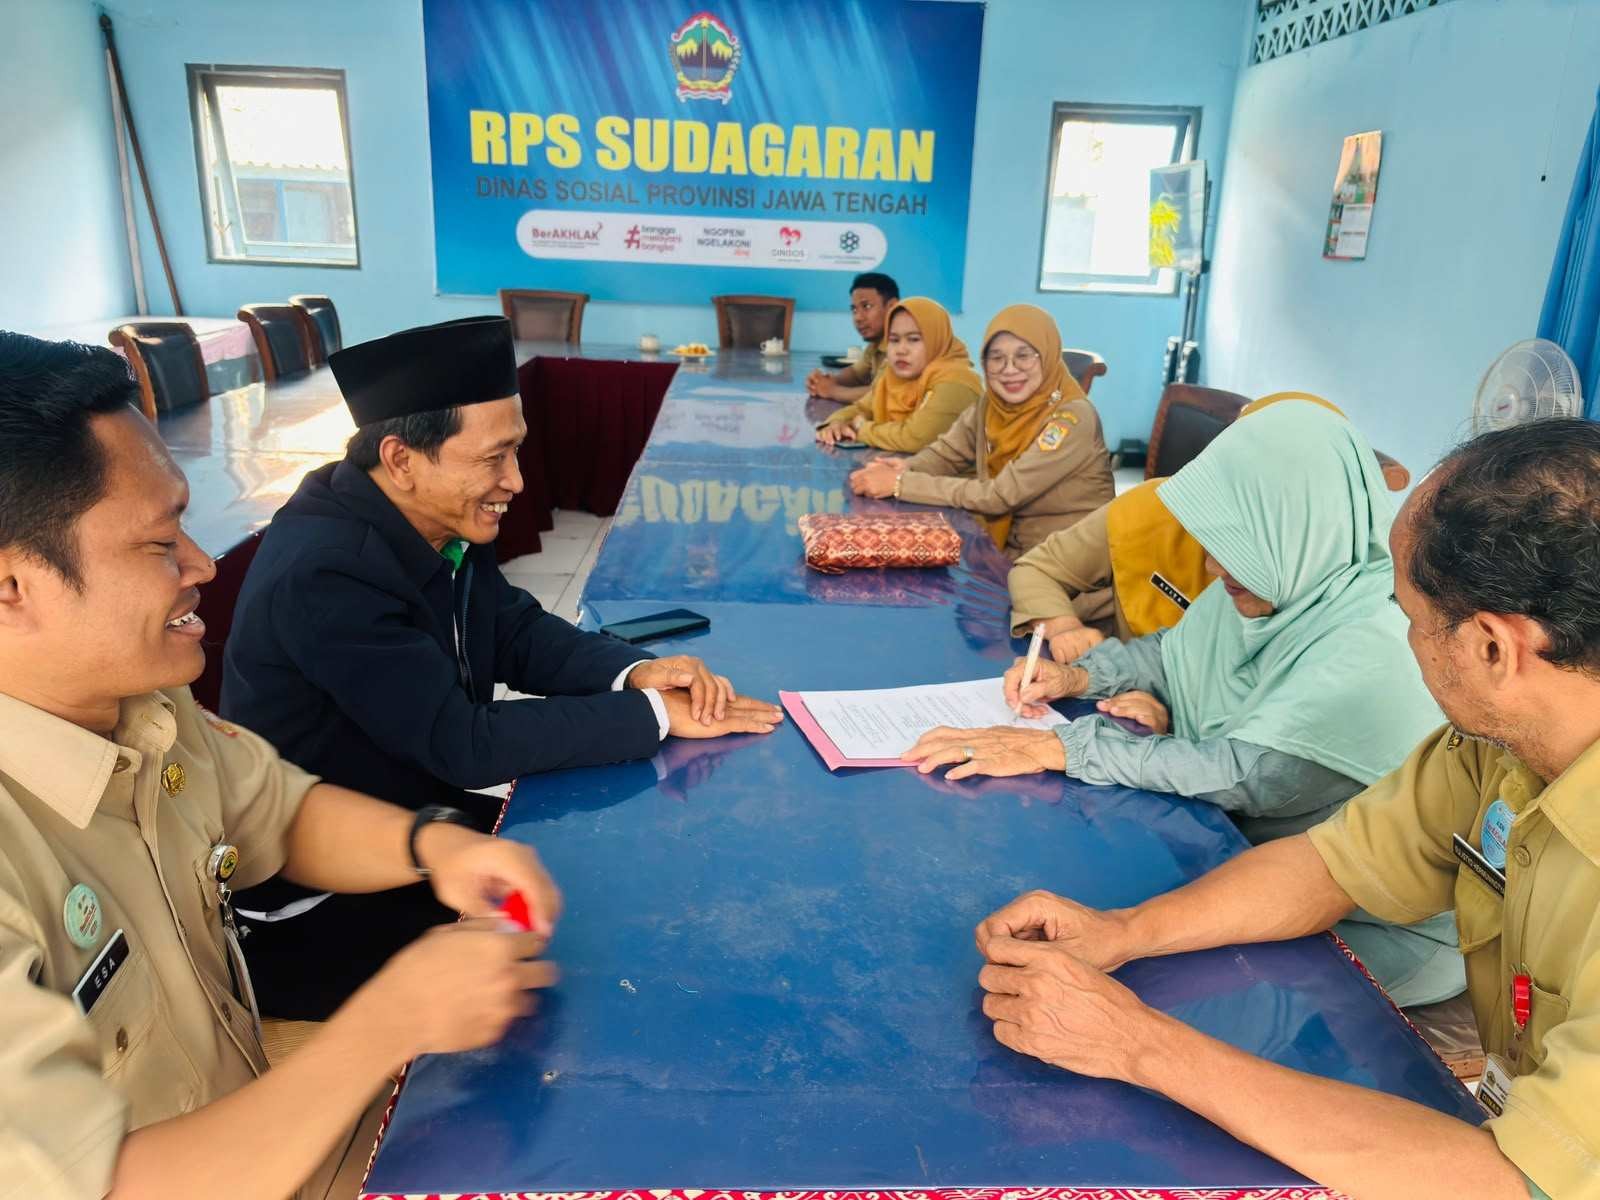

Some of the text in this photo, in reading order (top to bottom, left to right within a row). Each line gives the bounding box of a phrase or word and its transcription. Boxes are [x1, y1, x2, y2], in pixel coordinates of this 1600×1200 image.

[470, 109, 936, 183] RPS SUDAGARAN
[476, 176, 928, 215] DINAS SOSIAL PROVINSI JAWA TENGAH
[531, 227, 600, 241] BerAKHLAK
[94, 957, 116, 988] ESA
